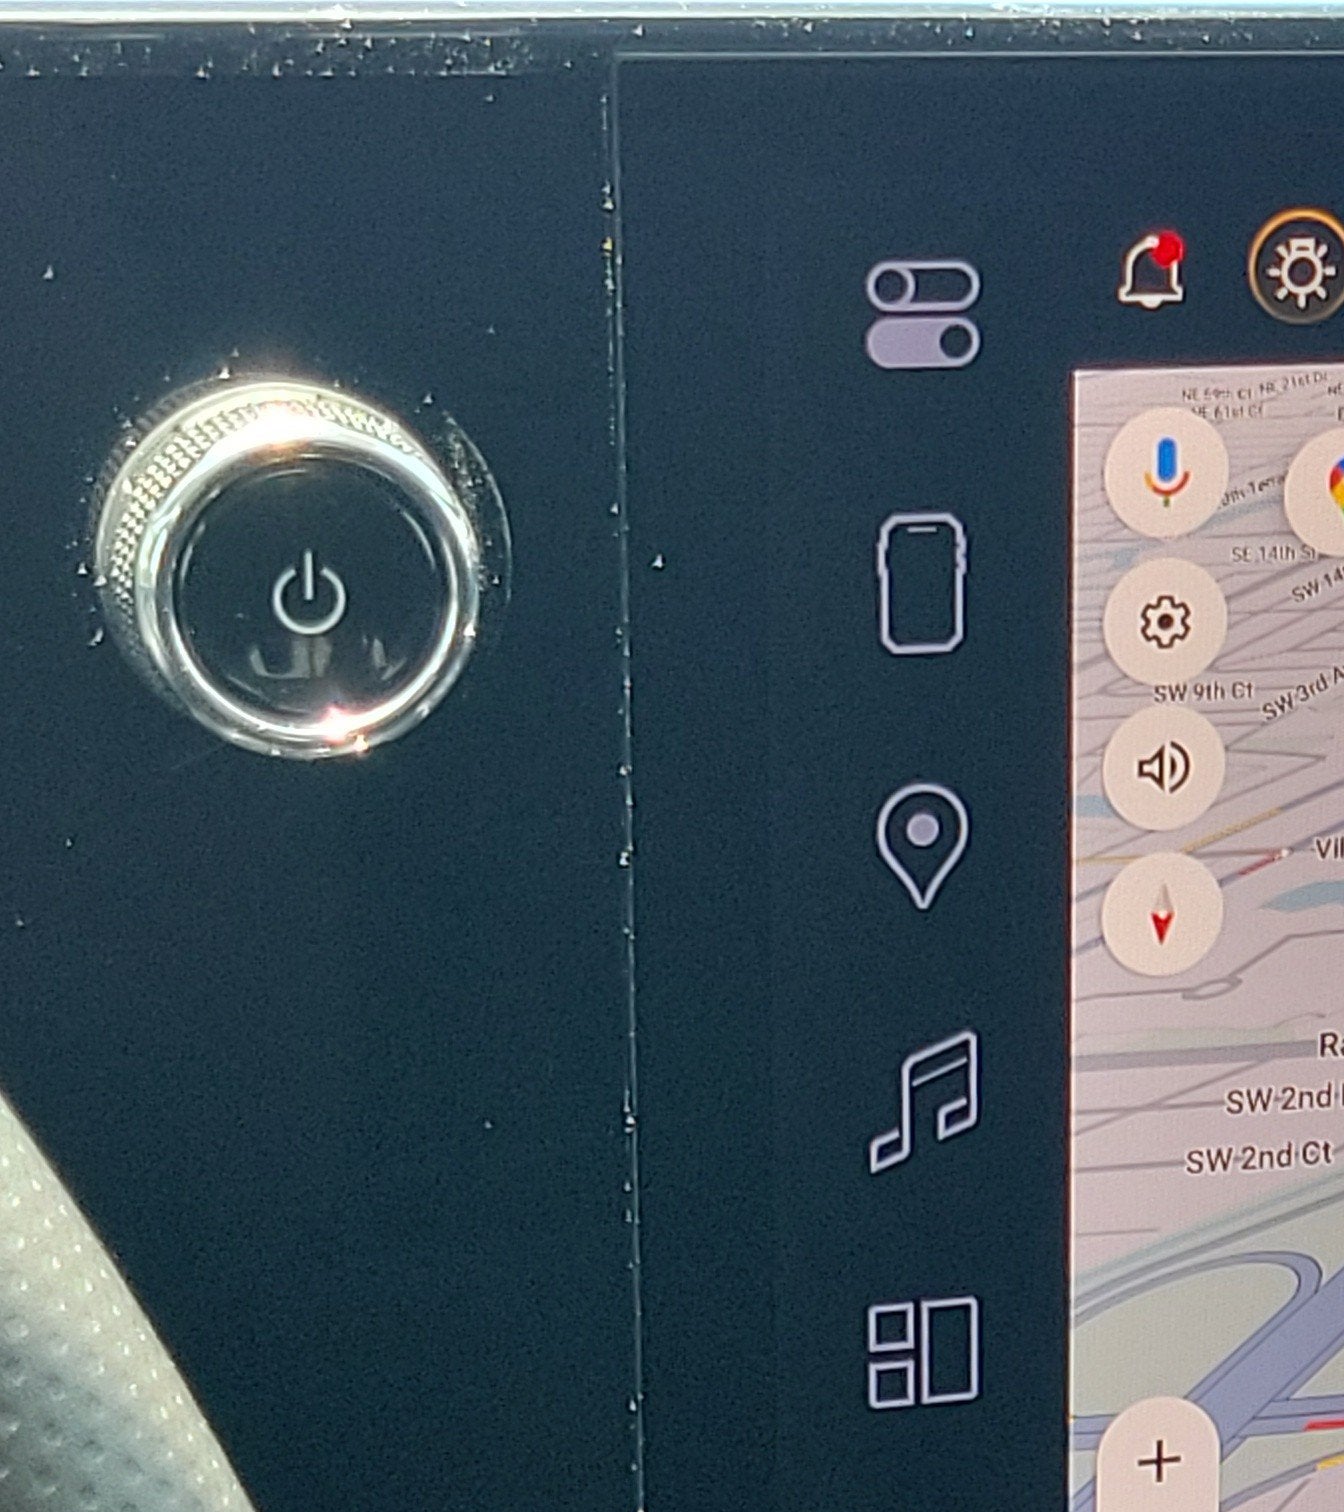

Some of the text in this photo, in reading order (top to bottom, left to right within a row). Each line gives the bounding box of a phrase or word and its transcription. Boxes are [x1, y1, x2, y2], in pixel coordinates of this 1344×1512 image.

[1292, 578, 1319, 602] SW
[1155, 682, 1252, 702] SW 9th Ct
[1262, 699, 1293, 721] SW
[1296, 675, 1327, 701] 3rd
[1226, 1089, 1273, 1114] SW
[1280, 1083, 1332, 1110] 2nd
[1186, 1140, 1332, 1174] SW 2nd Ct
